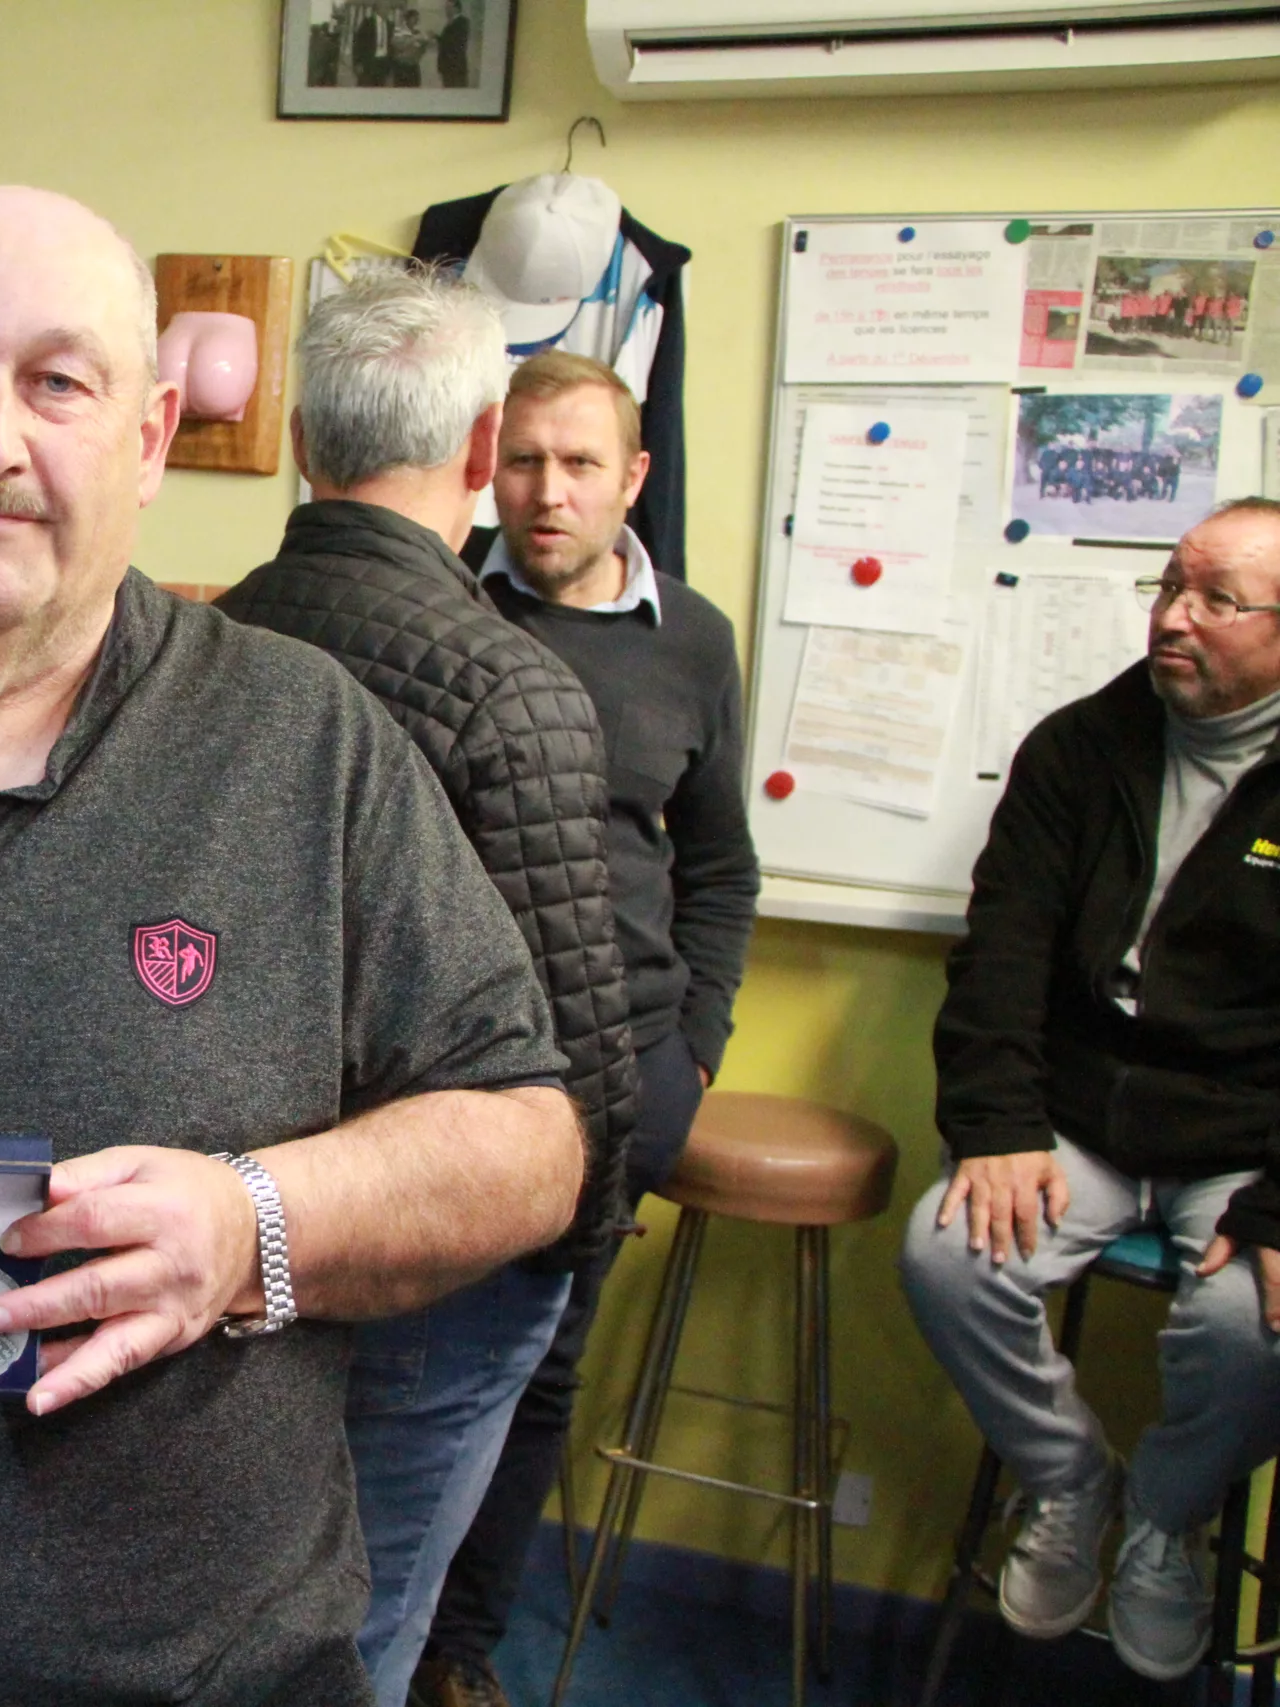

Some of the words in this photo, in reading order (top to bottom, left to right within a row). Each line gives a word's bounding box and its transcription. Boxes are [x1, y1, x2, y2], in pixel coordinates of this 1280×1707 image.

[897, 251, 924, 263] pour
[893, 267, 907, 276] se
[910, 265, 934, 276] fera
[893, 310, 909, 319] en
[912, 308, 949, 319] même
[952, 309, 991, 321] temps
[854, 325, 876, 336] que
[878, 324, 896, 334] les
[899, 323, 949, 334] licences
